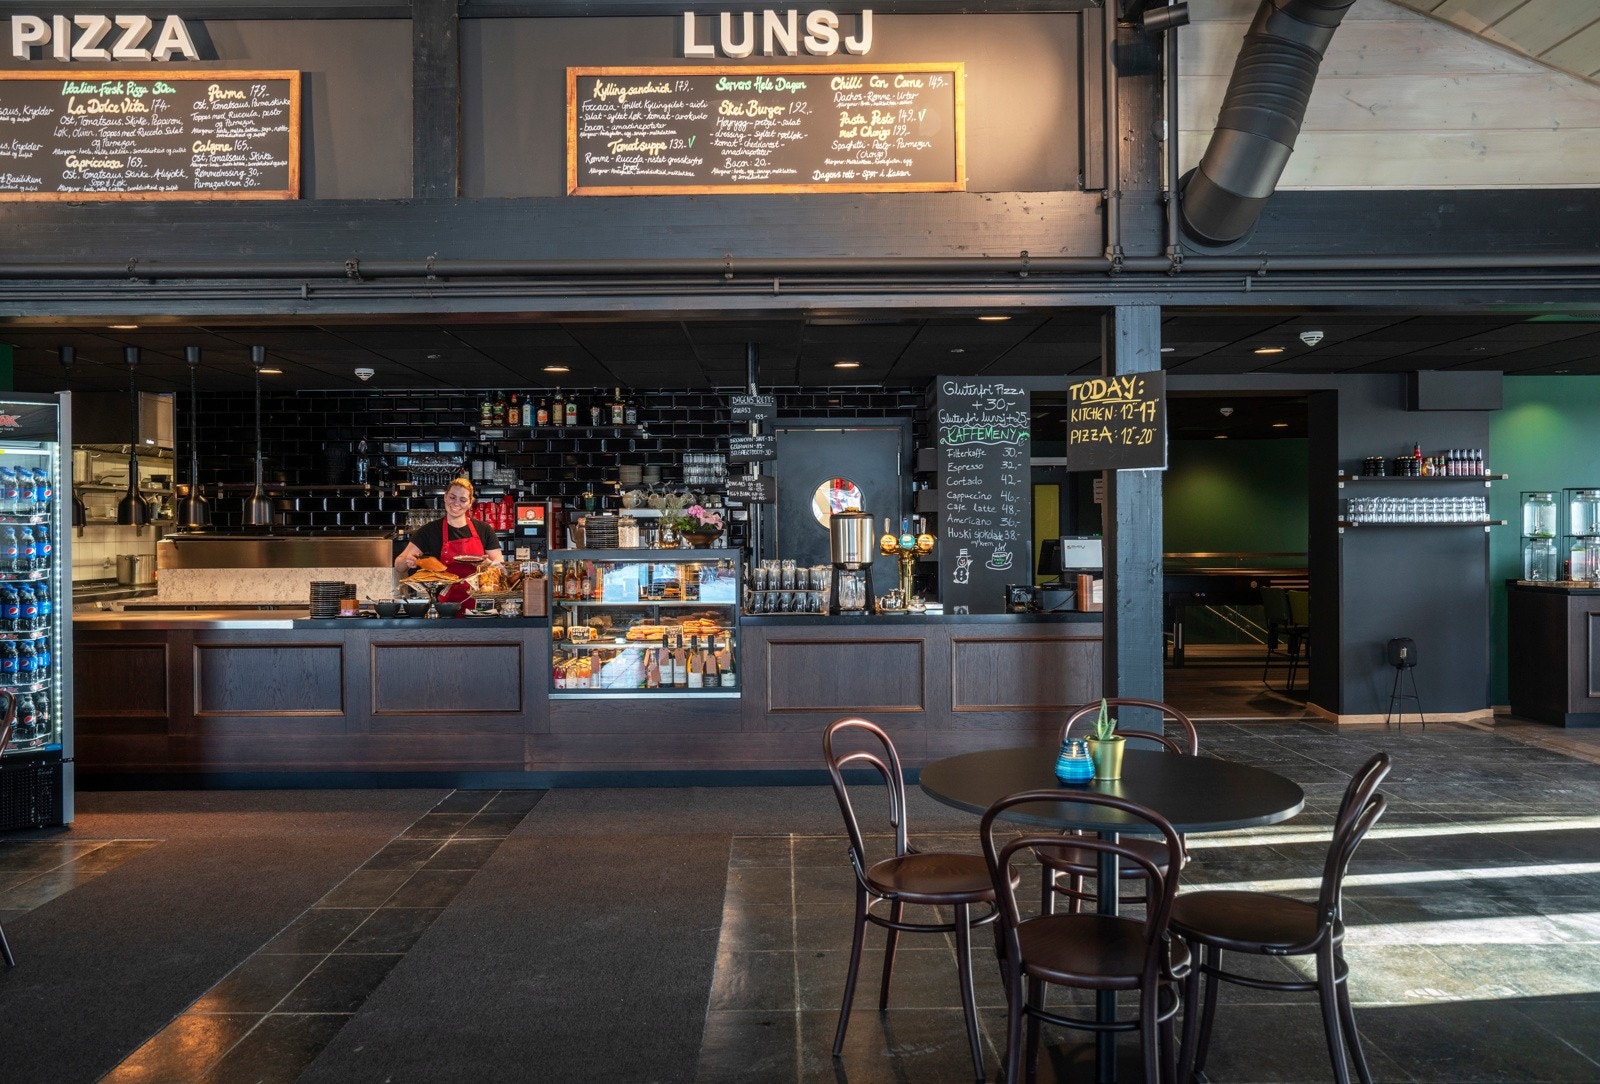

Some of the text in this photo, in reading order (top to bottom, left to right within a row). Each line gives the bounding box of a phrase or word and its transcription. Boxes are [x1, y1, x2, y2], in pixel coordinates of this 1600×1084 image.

[12, 15, 200, 62] PIZZA
[684, 9, 873, 58] LUNSJ
[869, 75, 889, 89] Con
[208, 84, 246, 101] Parma
[68, 96, 86, 114] La
[87, 99, 120, 114] Dolce
[120, 98, 149, 114] Vita
[745, 99, 786, 119] Burger
[1069, 375, 1145, 401] TODAY:
[1071, 405, 1118, 422] KITCHEN:
[947, 426, 1017, 443] KAFFEMENY
[1070, 425, 1118, 445] PIZZA:
[947, 462, 984, 474] Espresso
[946, 476, 983, 486] Cortado
[973, 503, 997, 513] latte
[946, 513, 992, 525] Americano
[947, 526, 972, 539] Huski
